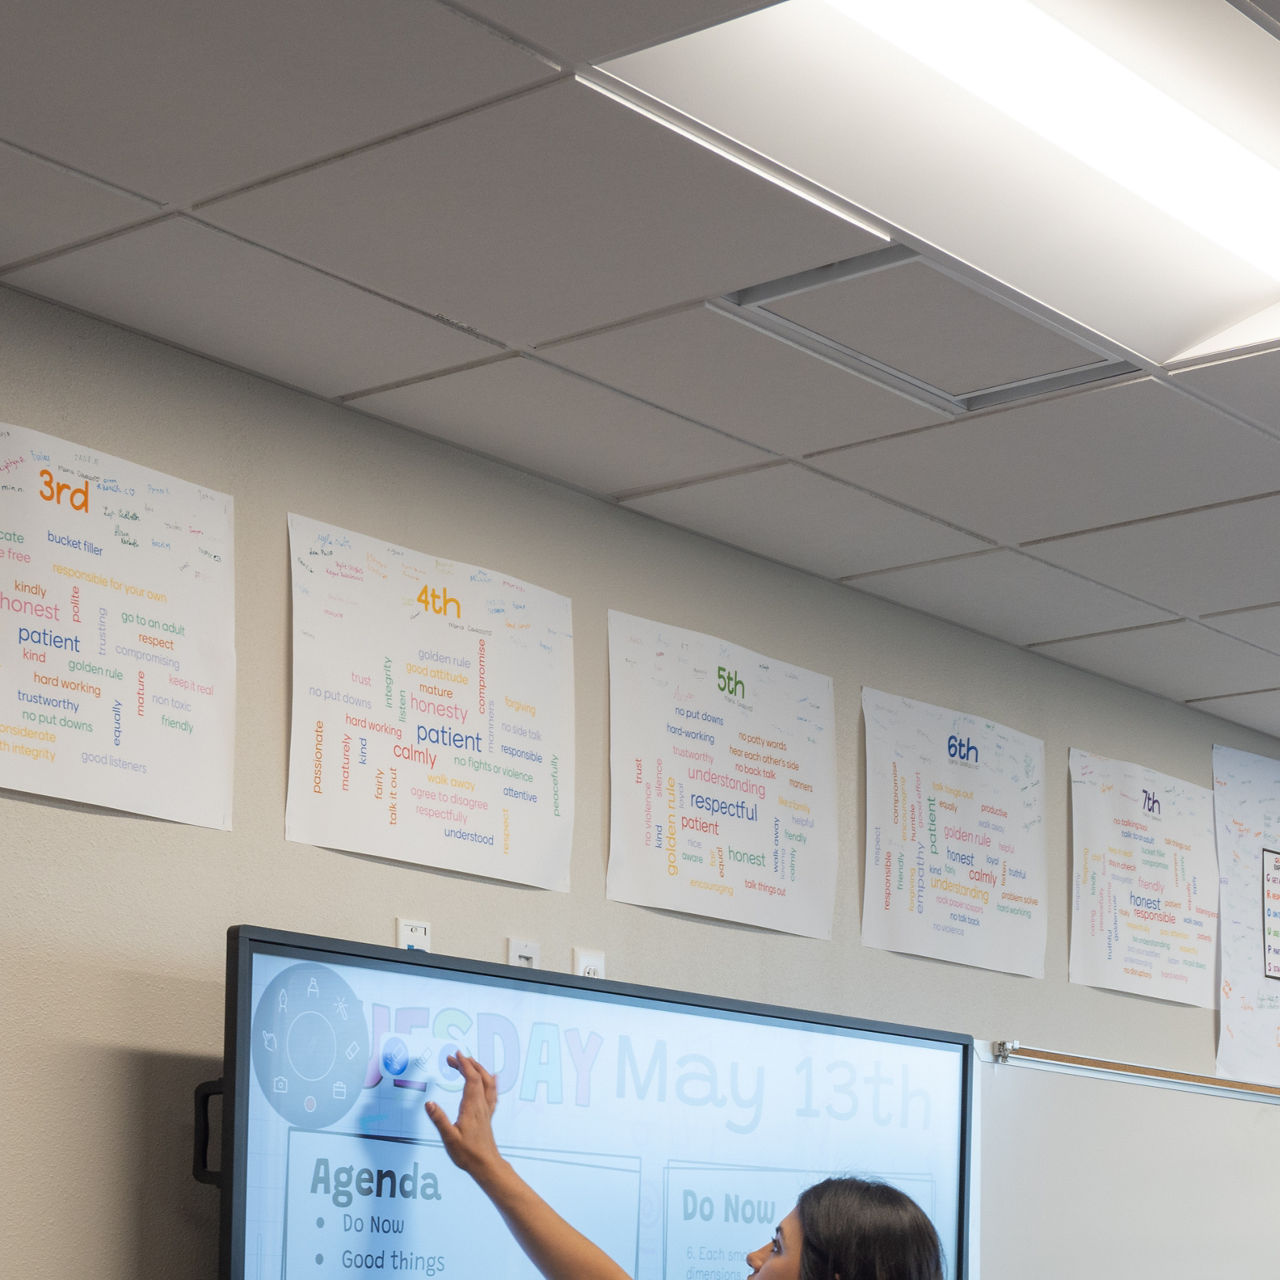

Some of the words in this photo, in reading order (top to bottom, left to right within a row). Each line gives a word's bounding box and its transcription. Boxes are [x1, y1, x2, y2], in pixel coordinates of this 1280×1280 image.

[39, 469, 89, 513] 3rd
[47, 530, 81, 552] bucket
[83, 540, 103, 557] filler
[14, 580, 46, 598] kindly
[416, 584, 461, 619] 4th
[0, 592, 60, 622] honest
[18, 626, 80, 653] patient
[139, 633, 173, 651] respect
[718, 666, 745, 698] 5th
[17, 690, 79, 713] trustworthy
[410, 693, 468, 724] honesty
[417, 722, 482, 753] patient
[948, 735, 978, 763] 6th
[314, 720, 323, 794] passionate
[393, 744, 437, 769] calmly
[688, 768, 766, 799] understanding
[691, 792, 757, 822] respectful
[1142, 789, 1160, 814] 7th
[444, 827, 494, 845] understood
[682, 815, 719, 836] patient
[728, 846, 765, 867] honest
[947, 847, 974, 866] honest
[616, 1036, 764, 1135] May
[796, 1057, 931, 1130] 13th
[310, 1159, 441, 1206] Agenda
[684, 1189, 714, 1222] Do
[724, 1193, 775, 1224] Now
[344, 1214, 365, 1234] Do
[369, 1214, 404, 1235] Now
[342, 1250, 389, 1270] Good
[391, 1250, 445, 1275] things
